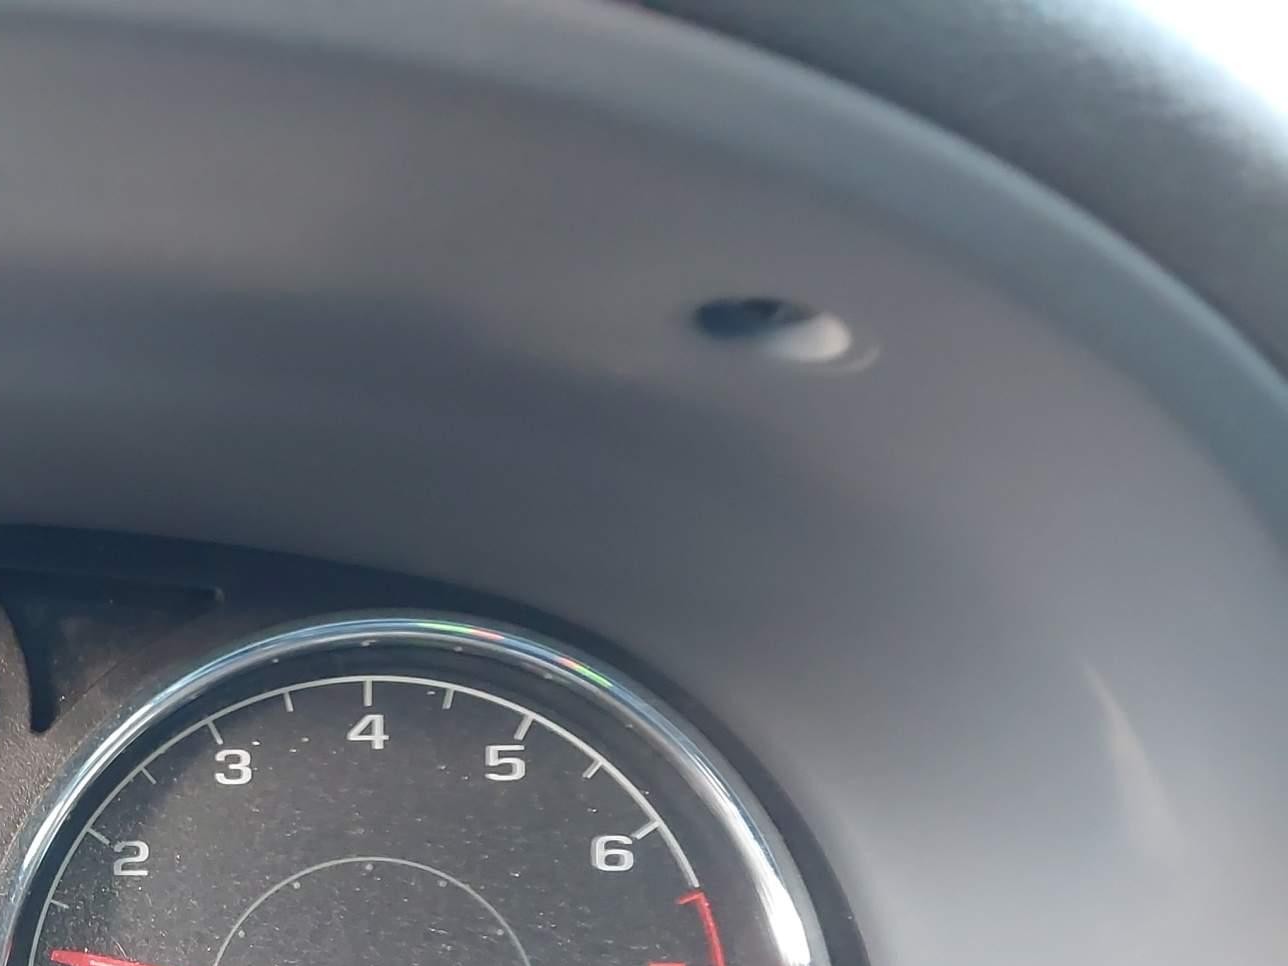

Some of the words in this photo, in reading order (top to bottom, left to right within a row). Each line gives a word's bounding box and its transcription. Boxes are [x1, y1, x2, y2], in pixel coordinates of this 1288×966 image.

[347, 714, 389, 750] 4
[215, 749, 252, 785] 3
[485, 745, 525, 781] 5
[113, 840, 150, 876] 2
[591, 835, 634, 871] 6
